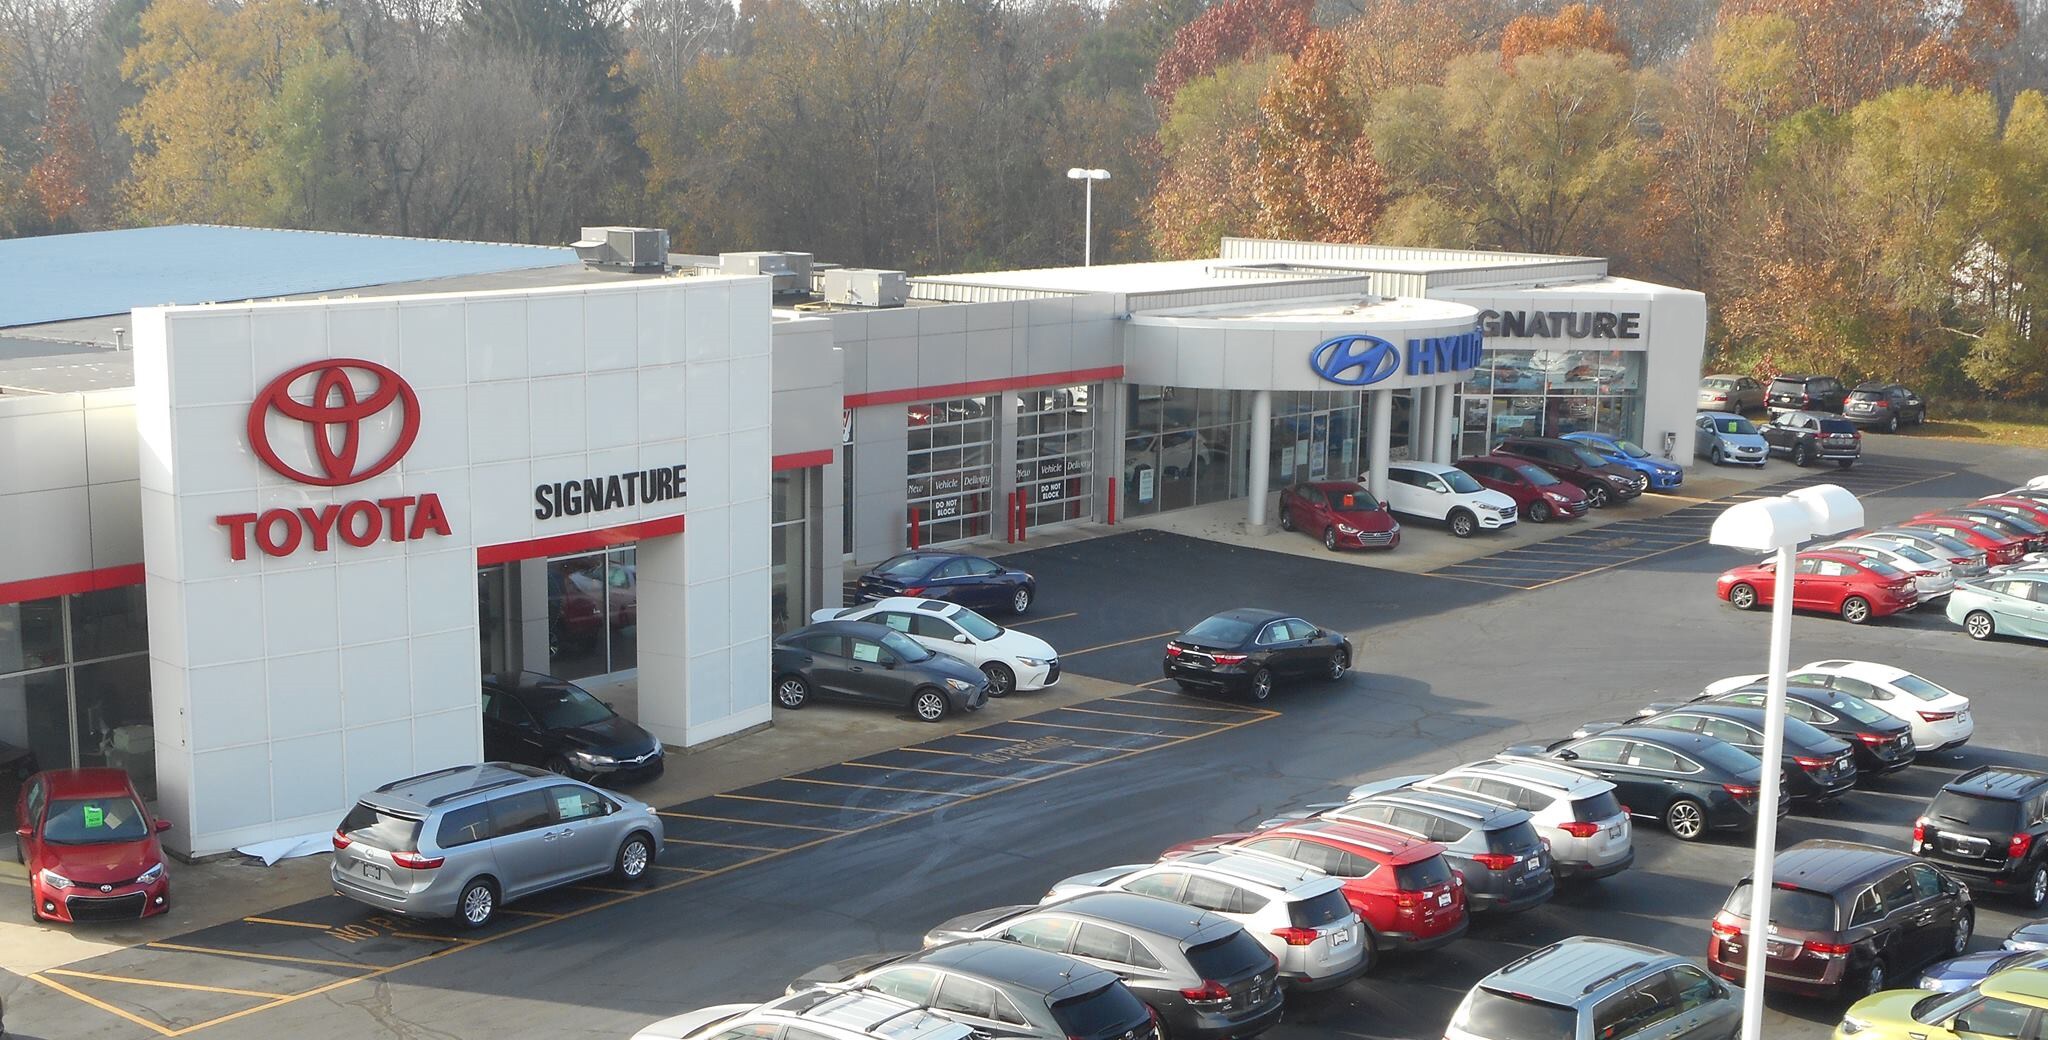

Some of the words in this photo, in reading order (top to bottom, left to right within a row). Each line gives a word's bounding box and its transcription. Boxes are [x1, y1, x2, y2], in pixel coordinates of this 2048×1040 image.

[1041, 464, 1062, 474] Vehicle
[935, 478, 959, 490] Vehicle
[964, 474, 991, 486] Delivery
[1041, 485, 1050, 493] DO
[1051, 482, 1061, 491] NOT
[535, 464, 687, 520] SIGNATURE
[1042, 490, 1060, 499] BLOCK
[935, 501, 944, 509] DO
[946, 499, 957, 508] NOT
[937, 506, 956, 516] BLOCK
[216, 493, 453, 561] TOYOTA
[324, 923, 379, 943] NO
